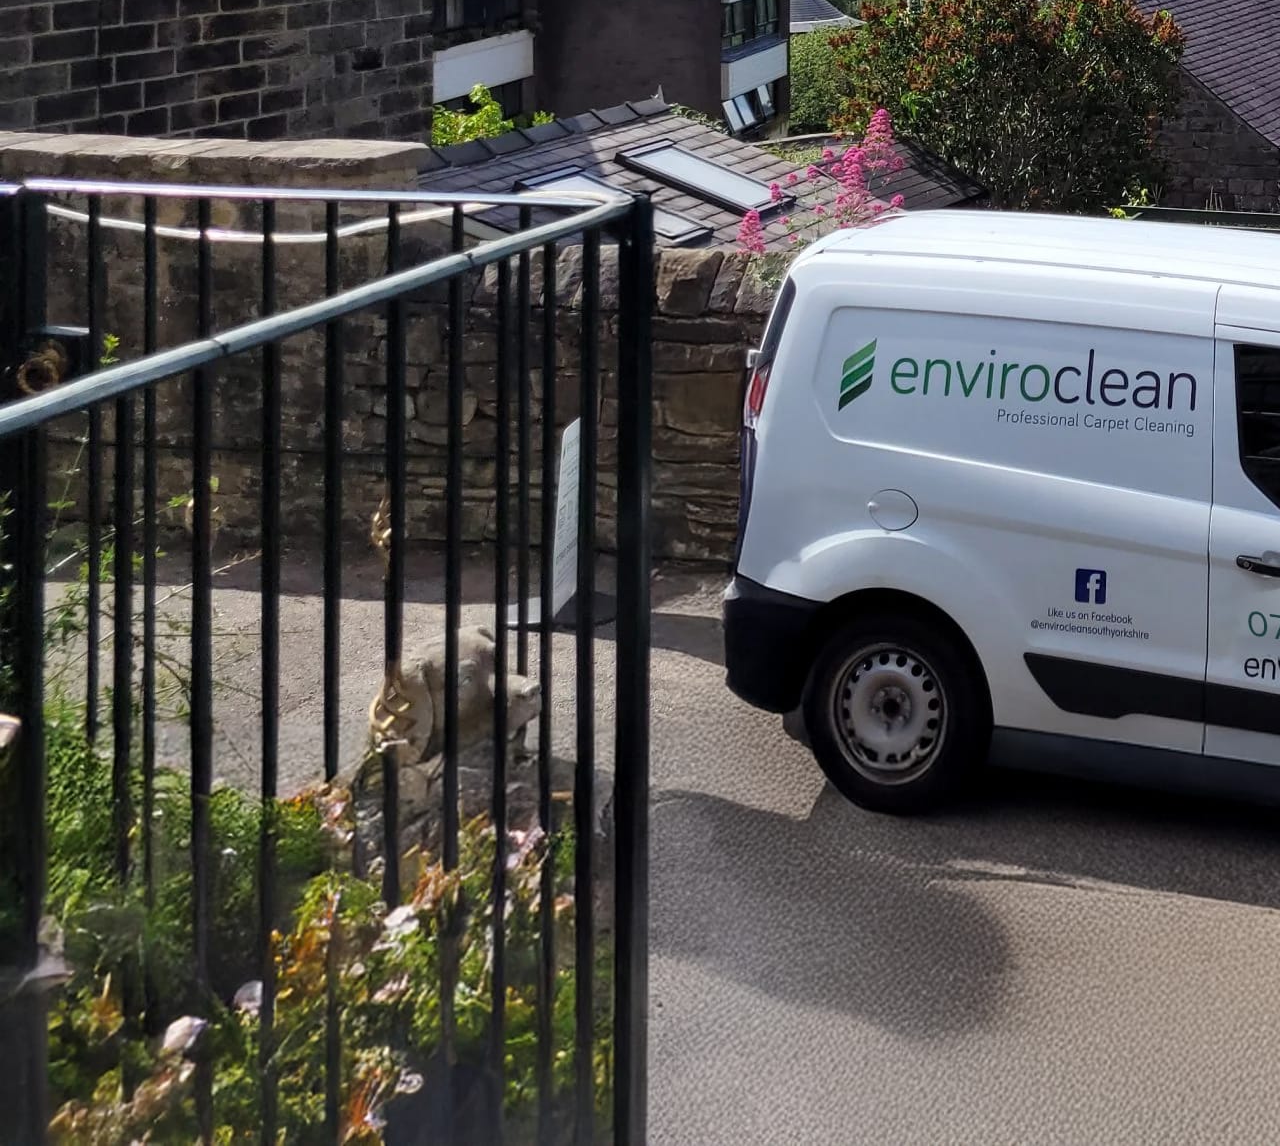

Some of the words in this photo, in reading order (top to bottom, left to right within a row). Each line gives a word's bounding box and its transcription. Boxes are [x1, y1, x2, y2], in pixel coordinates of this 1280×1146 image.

[889, 348, 1198, 412] enviroclean
[996, 408, 1079, 429] Professional
[1083, 413, 1130, 433] Carpet
[1134, 416, 1196, 438] Cleaning
[1030, 618, 1150, 640] @envirocleansouthyorkshire
[1047, 607, 1064, 619] Like
[1065, 610, 1076, 620] us
[1078, 611, 1089, 621] on
[1091, 611, 1133, 625] Facebook
